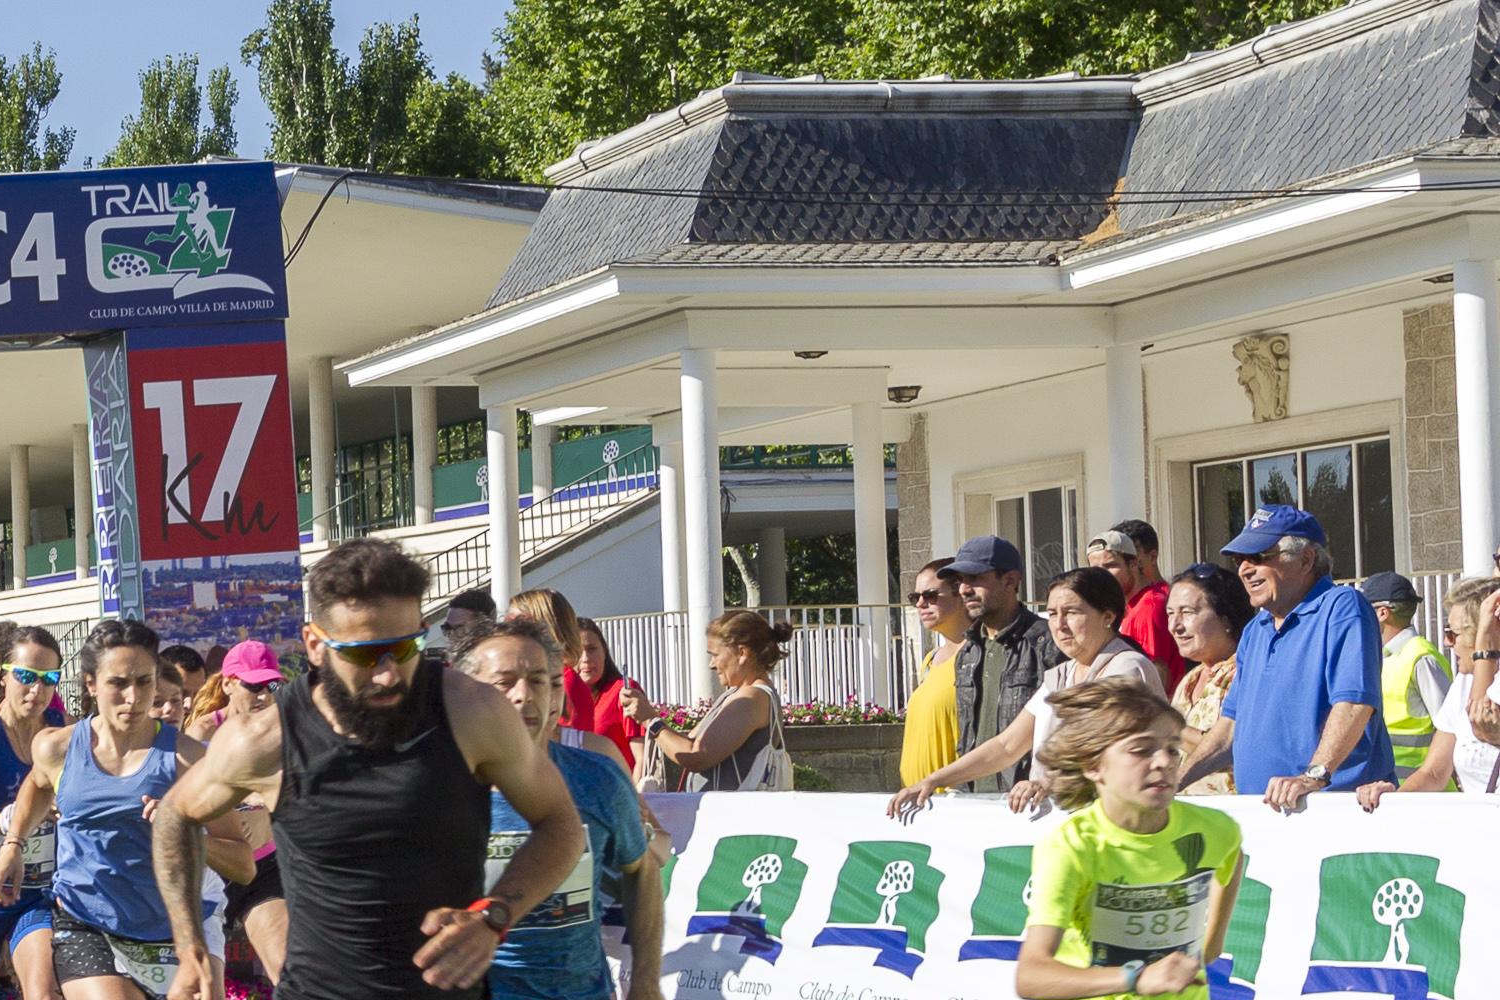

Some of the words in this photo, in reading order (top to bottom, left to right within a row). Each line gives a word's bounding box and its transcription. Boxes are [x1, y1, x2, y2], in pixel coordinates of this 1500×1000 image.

[81, 181, 192, 216] TRAIL
[89, 307, 118, 319] CLUB
[120, 306, 135, 317] DE
[136, 304, 177, 317] CAMPO
[179, 302, 211, 315] VILLA
[213, 301, 228, 312] DE
[229, 299, 274, 311] MADRID
[142, 374, 278, 524] 17
[87, 350, 121, 617] RRERA
[163, 452, 279, 541] Km
[1124, 910, 1190, 936] 582
[677, 969, 706, 991] Club
[709, 971, 722, 991] de
[727, 973, 772, 1000] Campo
